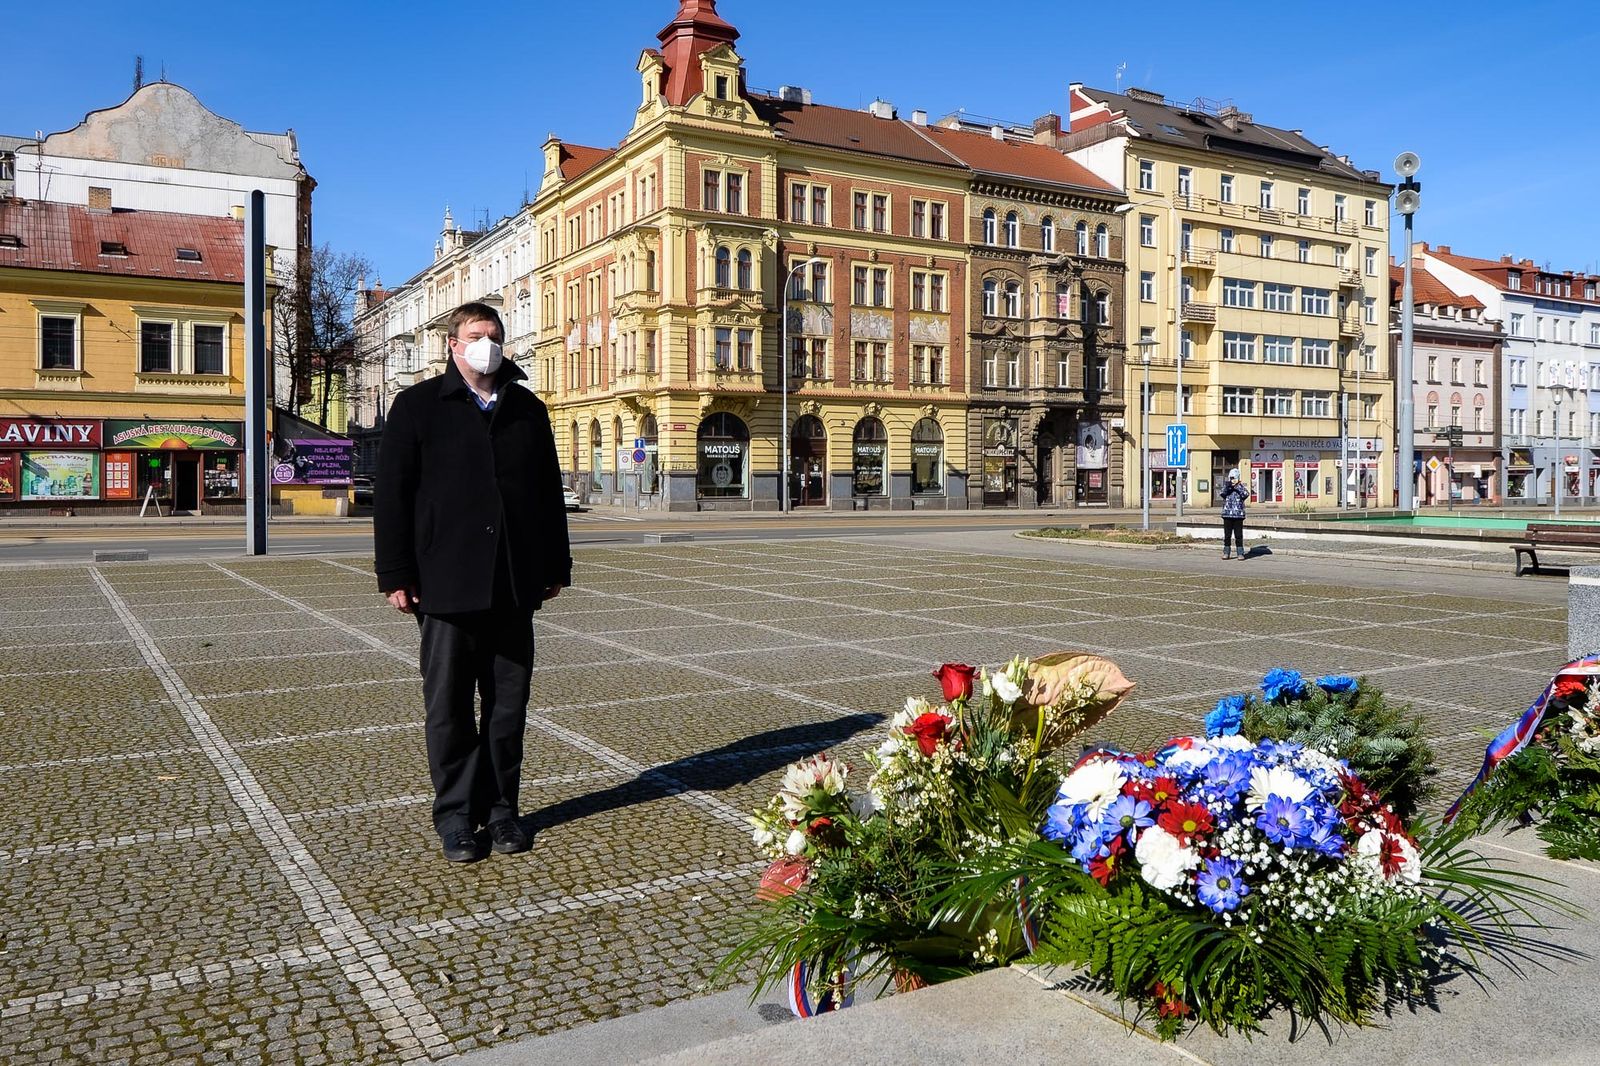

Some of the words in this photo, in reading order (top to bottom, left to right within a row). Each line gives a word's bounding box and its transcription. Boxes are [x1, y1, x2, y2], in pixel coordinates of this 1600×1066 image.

[0, 423, 93, 442] AVINY
[112, 424, 148, 445] ASIJSKÁ
[148, 424, 203, 434] RESTAURACE
[705, 443, 741, 454] MATOUŠ
[857, 445, 881, 453] MATOUŠ
[915, 446, 938, 454] MATOUŠ
